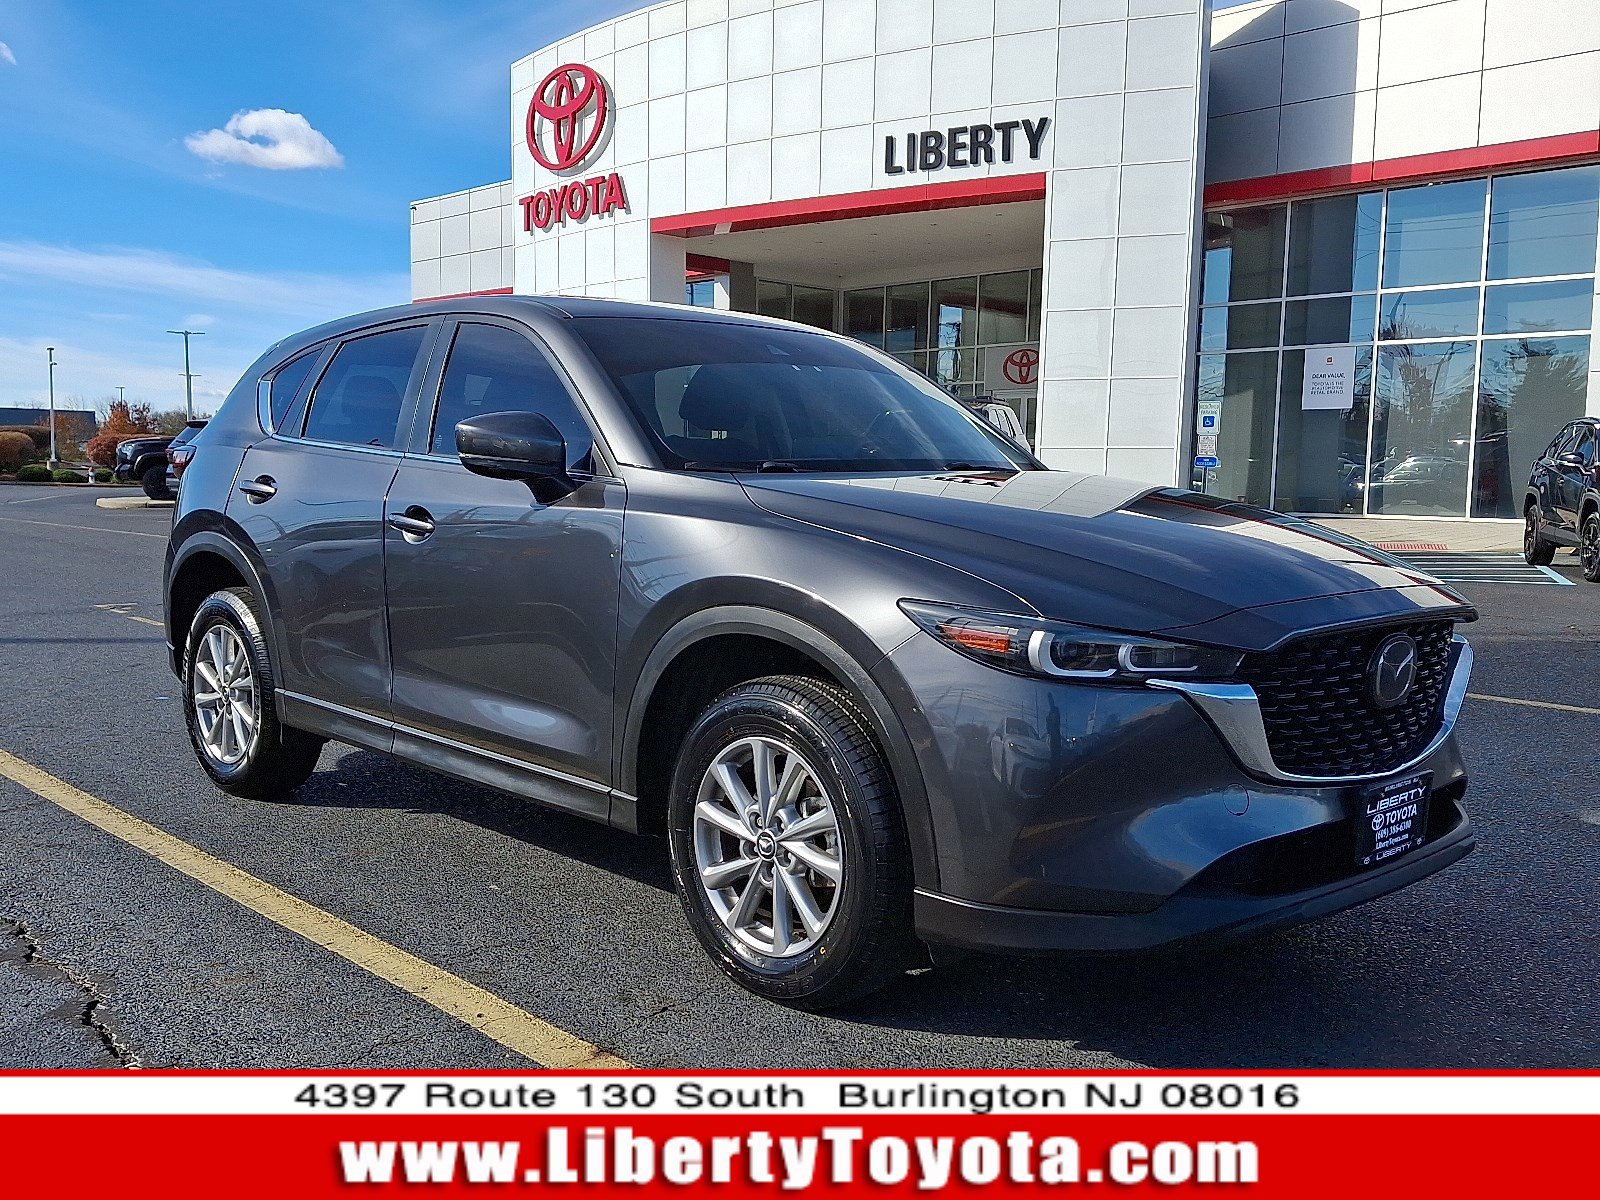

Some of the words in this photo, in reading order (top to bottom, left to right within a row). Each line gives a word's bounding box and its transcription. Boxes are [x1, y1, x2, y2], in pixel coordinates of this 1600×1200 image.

[884, 116, 1050, 175] LIBERTY
[518, 172, 627, 233] TOYOTA
[1366, 786, 1426, 814] LIBERTY
[1385, 803, 1417, 825] TOYOTA
[1376, 842, 1412, 860] LIBERTY
